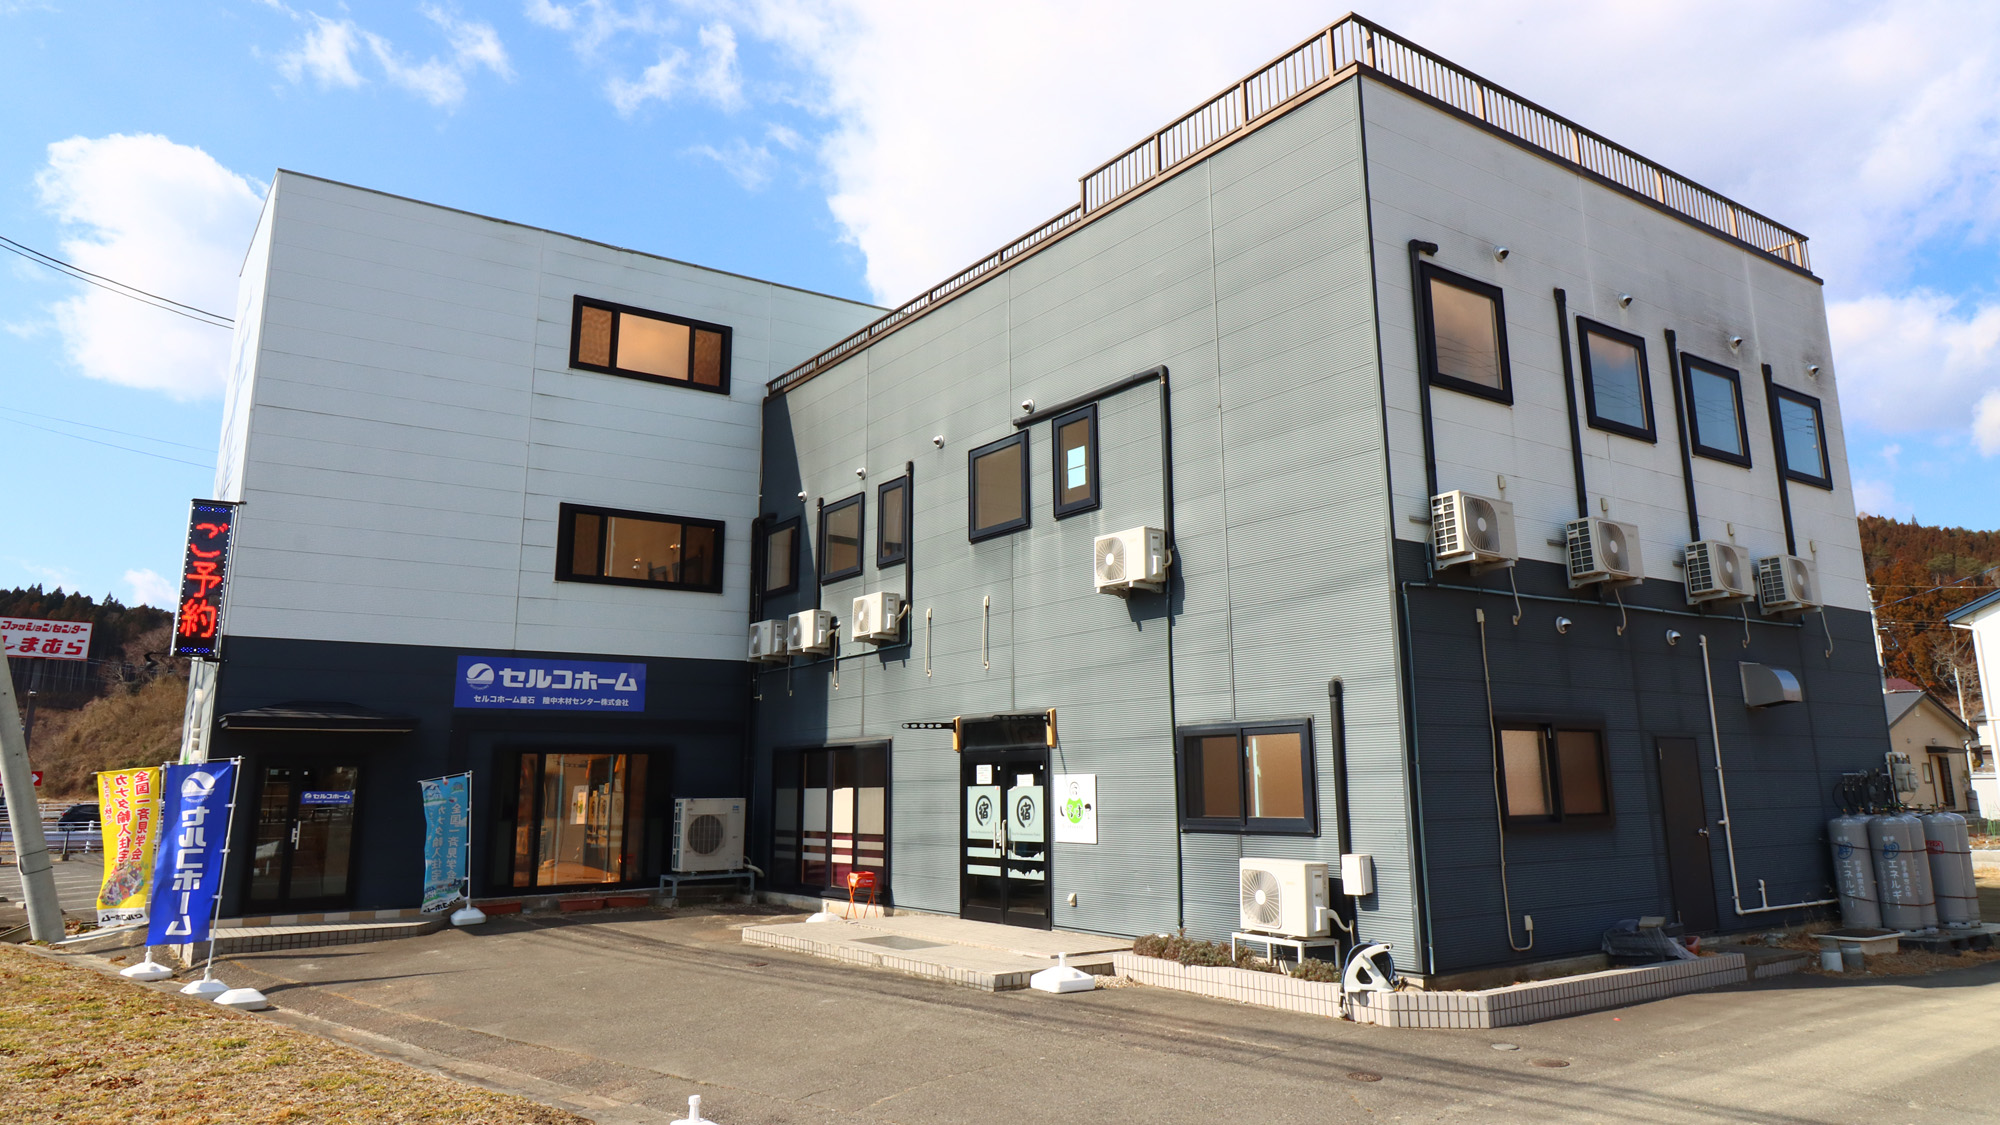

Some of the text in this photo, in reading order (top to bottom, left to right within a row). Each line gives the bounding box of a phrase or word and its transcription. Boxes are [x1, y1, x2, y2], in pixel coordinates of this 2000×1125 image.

[179, 522, 228, 638] ご予約
[1, 620, 87, 634] ファッションセンター
[499, 667, 638, 692] セルコホーム
